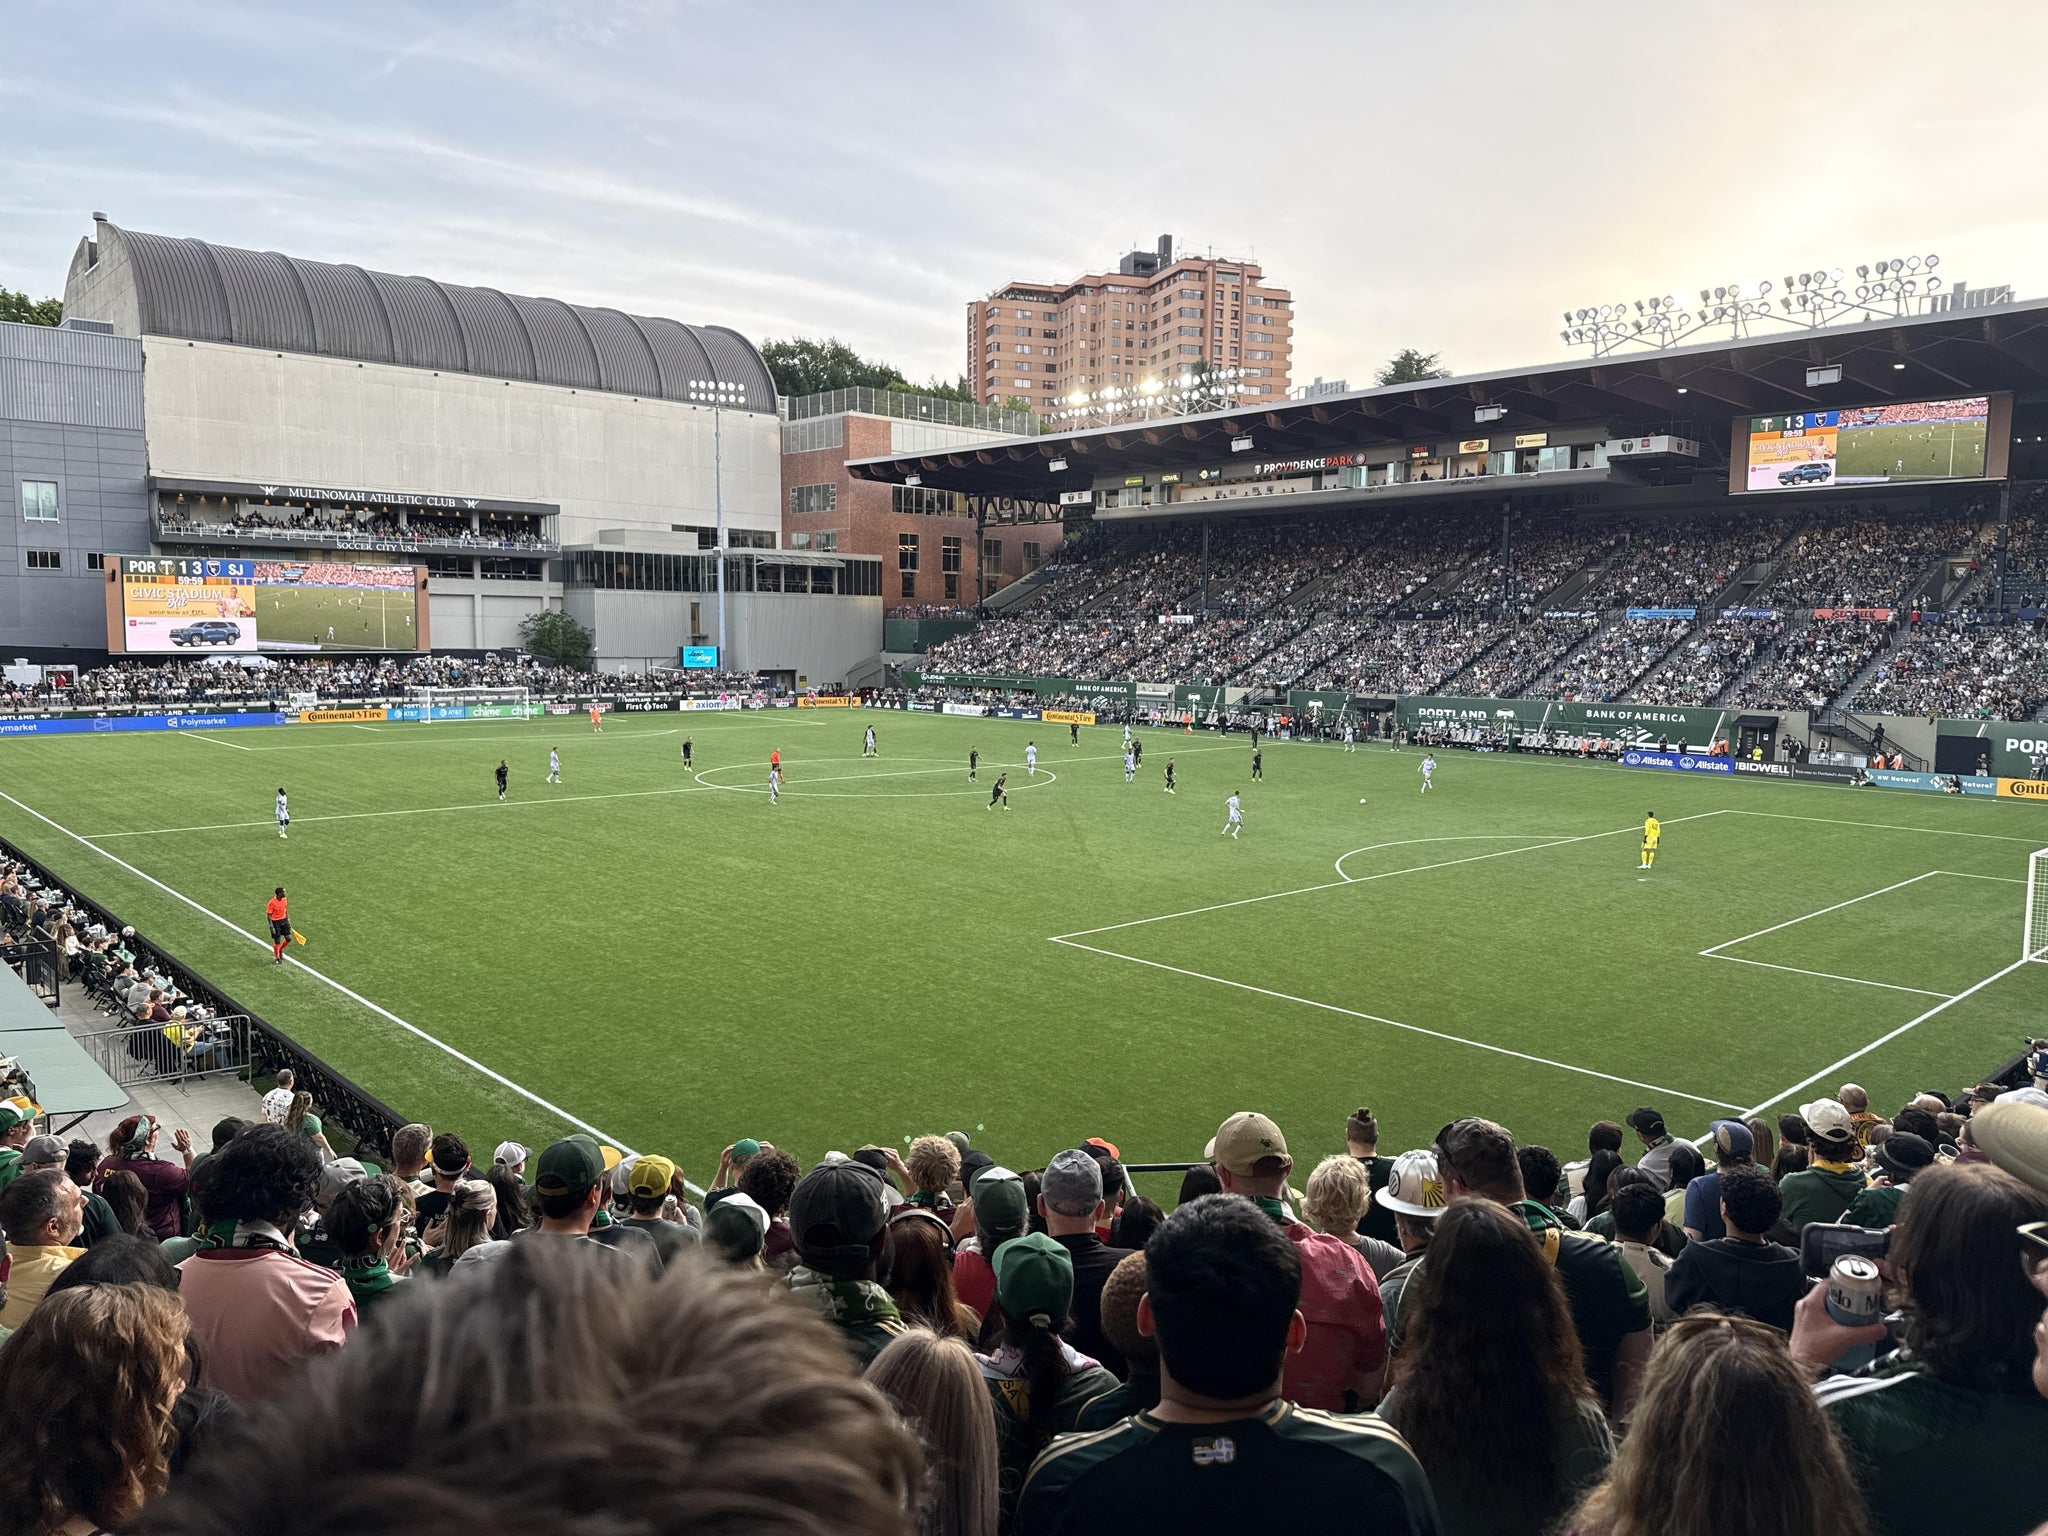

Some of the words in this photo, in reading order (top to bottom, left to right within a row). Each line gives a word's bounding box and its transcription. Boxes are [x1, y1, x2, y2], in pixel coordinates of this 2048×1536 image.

[1784, 416, 1792, 429] 1
[1795, 415, 1805, 428] 3
[1263, 458, 1326, 474] PROVIDENCE
[1326, 455, 1353, 467] PARK
[288, 488, 365, 502] MULTNOMAH
[369, 493, 422, 505] ATHLETIC
[426, 497, 456, 507] CLUB
[336, 542, 372, 550] SOCCER
[376, 543, 397, 552] CITY
[400, 545, 419, 553] USA
[129, 560, 156, 573] POR
[179, 561, 187, 575] 1
[192, 561, 203, 575] 3
[228, 563, 244, 576] SJ
[177, 576, 204, 586] 59:59
[129, 587, 165, 599] CIVIC
[167, 588, 223, 600] STADIUM
[308, 711, 357, 722] Continental
[473, 706, 501, 716] chime
[1046, 711, 1075, 720] Continental
[1586, 709, 1616, 719] BANK
[1618, 711, 1632, 719] OF
[1634, 712, 1686, 722] AMERICA
[181, 718, 226, 726] Polymarket
[1641, 756, 1673, 766] Allstate
[1695, 760, 1729, 771] Allstate
[1738, 762, 1790, 774] BIDWELL
